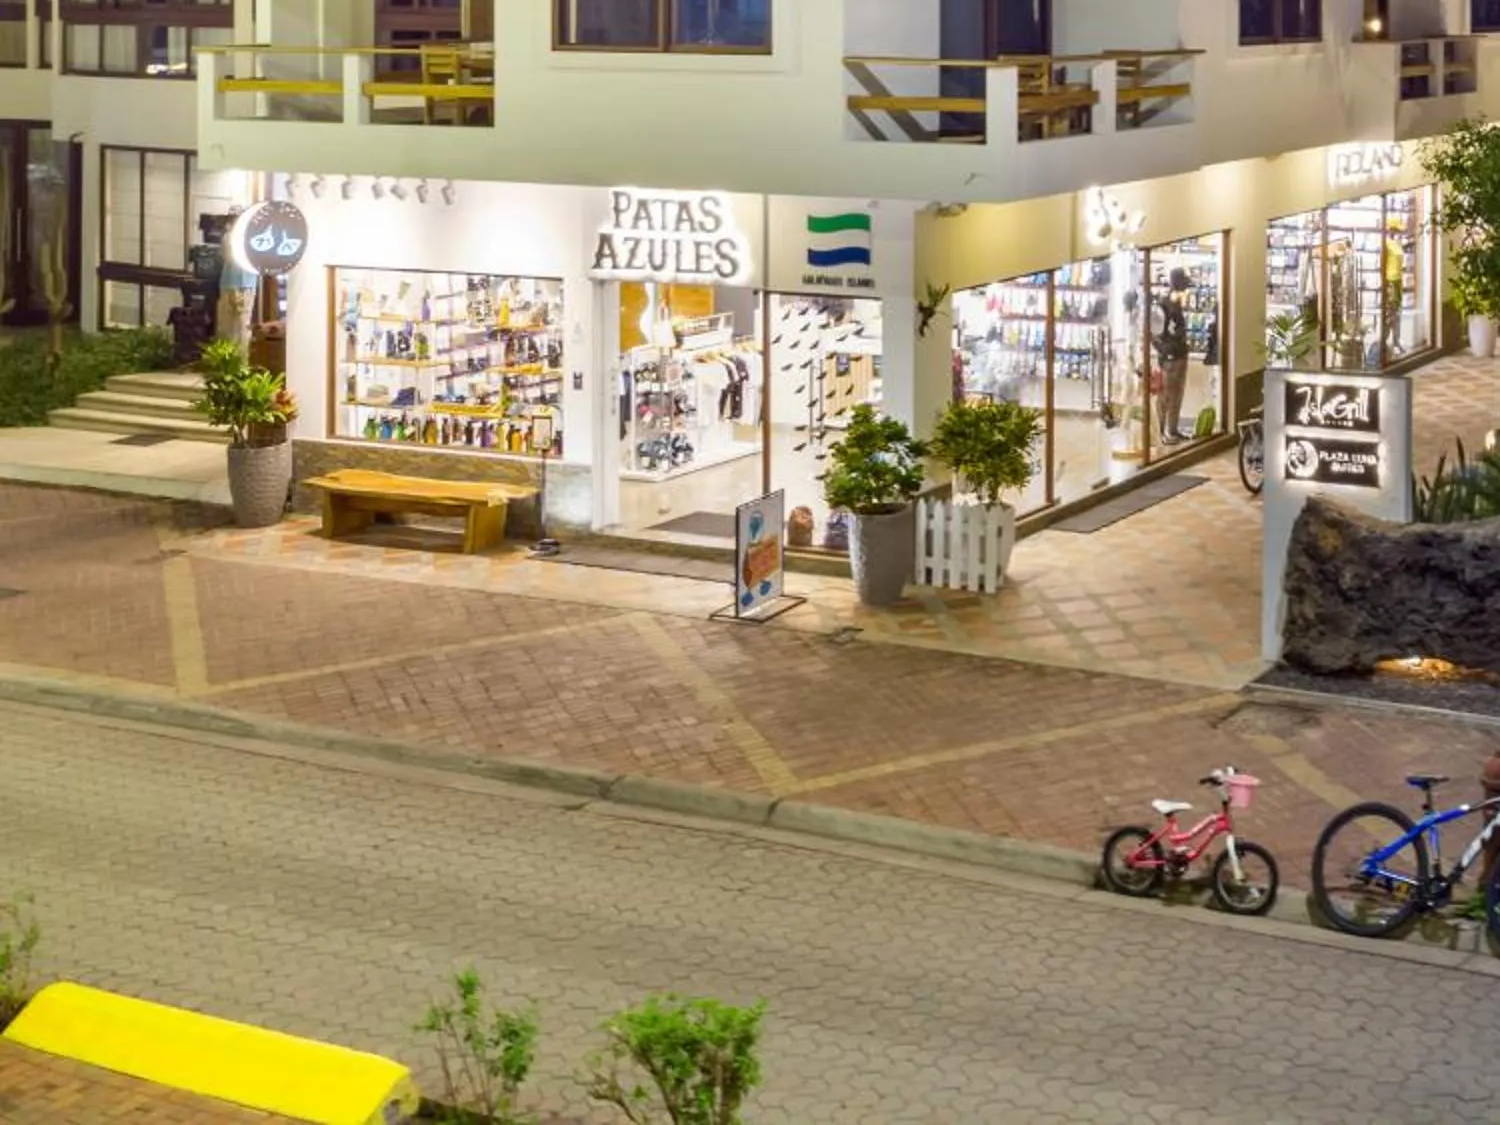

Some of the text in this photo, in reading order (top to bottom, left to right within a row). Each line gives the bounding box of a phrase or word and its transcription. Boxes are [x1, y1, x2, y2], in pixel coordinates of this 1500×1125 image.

[612, 190, 722, 233] PATAS
[591, 233, 740, 278] AZULES
[1318, 450, 1349, 463] PLAZA
